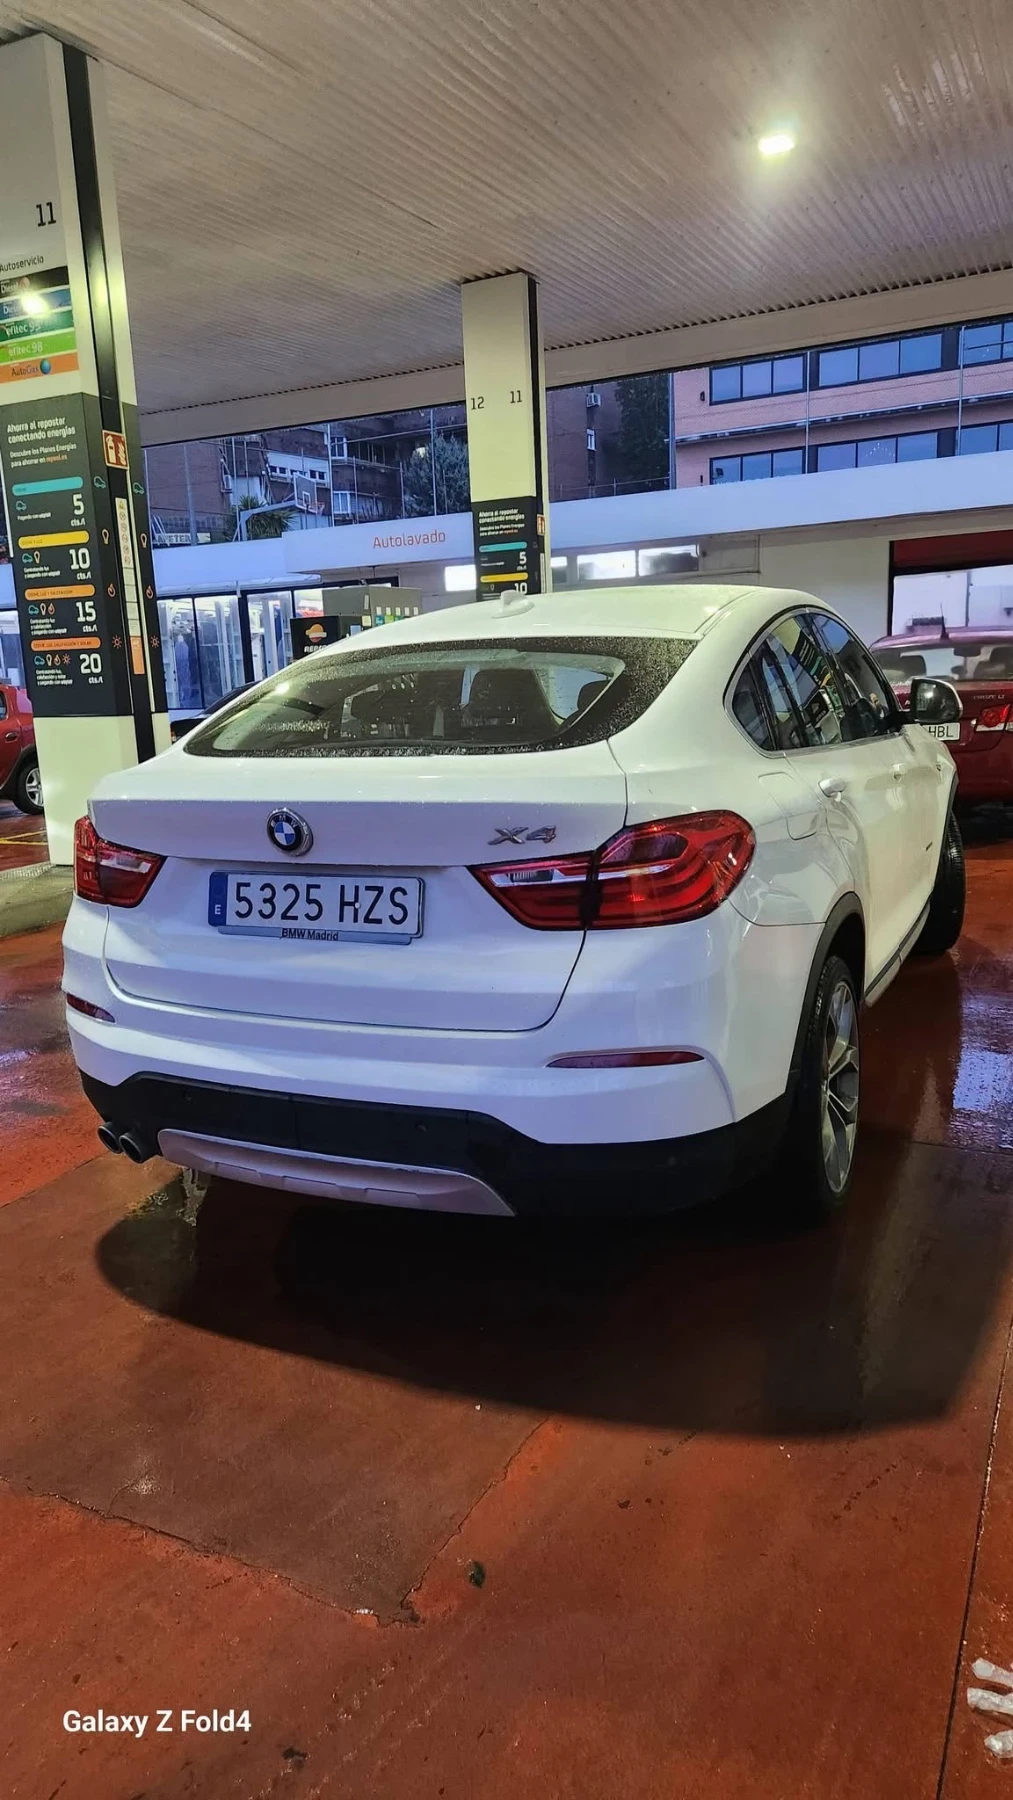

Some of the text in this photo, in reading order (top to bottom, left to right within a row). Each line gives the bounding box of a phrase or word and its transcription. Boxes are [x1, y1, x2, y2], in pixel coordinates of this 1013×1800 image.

[36, 201, 57, 227] 11
[0, 254, 44, 273] Autoservicio
[31, 341, 43, 354] 98
[11, 364, 39, 377] AutoGas
[471, 390, 522, 410] 12 11
[7, 417, 66, 433] Ahorra al repostar
[8, 426, 76, 444] conectando energías
[72, 493, 85, 515] 5
[373, 529, 446, 549] Autolavado
[69, 547, 91, 570] 10
[519, 551, 527, 565] 5
[514, 582, 528, 595] 10
[76, 601, 96, 622] 15
[79, 653, 102, 674] 20
[928, 725, 954, 738] HBL
[487, 825, 557, 846] X4
[214, 904, 222, 915] E
[234, 881, 409, 925] 5325 HZS
[281, 928, 339, 941] BMW Madrid
